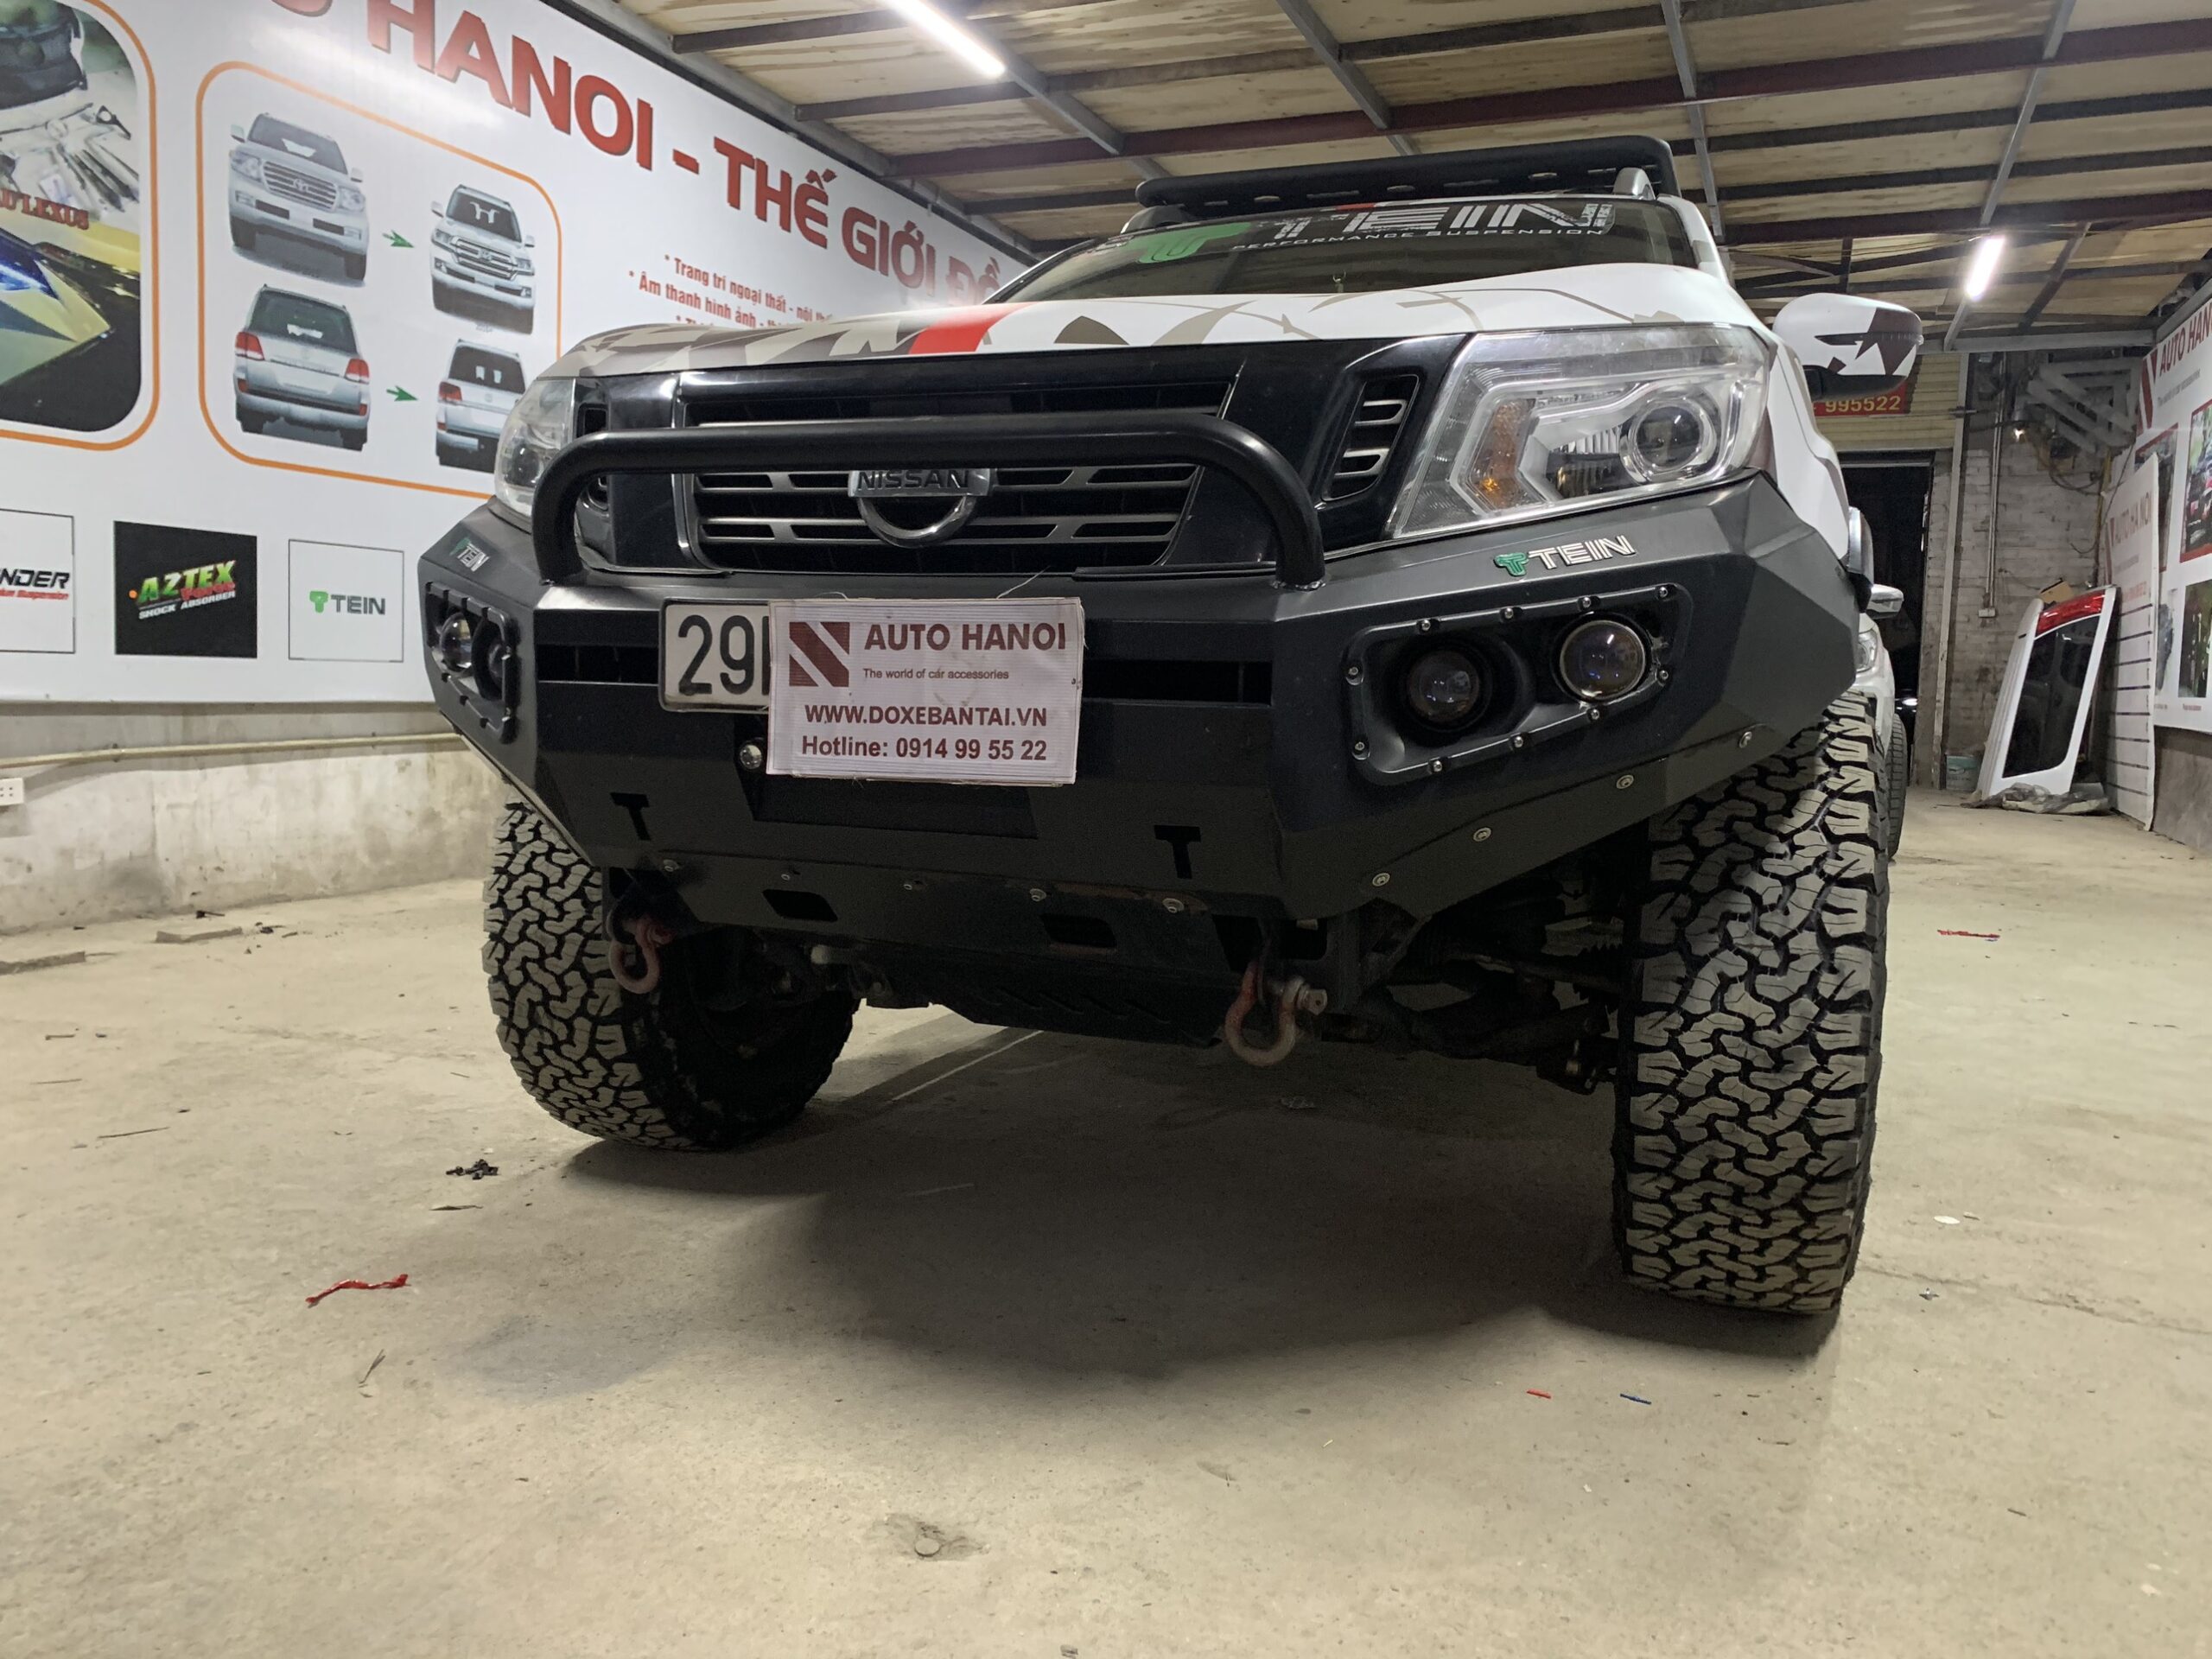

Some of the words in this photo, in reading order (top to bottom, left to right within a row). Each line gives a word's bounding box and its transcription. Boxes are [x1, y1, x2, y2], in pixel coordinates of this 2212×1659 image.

[366, 0, 653, 171] HANOI
[714, 137, 837, 250] THẾ
[842, 207, 936, 297] GIỚI
[1259, 203, 1614, 241] TEIN
[1232, 232, 1414, 251] PERFORMANCE
[1426, 229, 1604, 238] SUSPENSION
[639, 270, 661, 296] Âm
[665, 283, 702, 310] thanh
[674, 257, 709, 287] Trang
[729, 280, 762, 306] ngoại
[2159, 327, 2186, 378] AUTO
[858, 469, 969, 490] NISSAN
[1528, 535, 1637, 569] TEIN
[138, 560, 236, 604] AZTEX
[138, 603, 177, 620] SHOCK
[180, 590, 236, 609] ABSORBER
[330, 594, 386, 615] TEIN
[864, 623, 950, 651] AUTO
[962, 622, 1066, 651] HANOI
[677, 614, 770, 697] 29
[863, 668, 883, 679] The
[886, 668, 913, 680] world
[916, 669, 926, 679] of
[947, 670, 1009, 680] accessories
[804, 704, 1047, 727] WWW.DOXEBANTAI.VN
[802, 735, 888, 758] Hotline:
[895, 738, 948, 759] 0914
[955, 739, 981, 759] 99
[987, 740, 1014, 760] 55
[1020, 740, 1047, 760] 22
